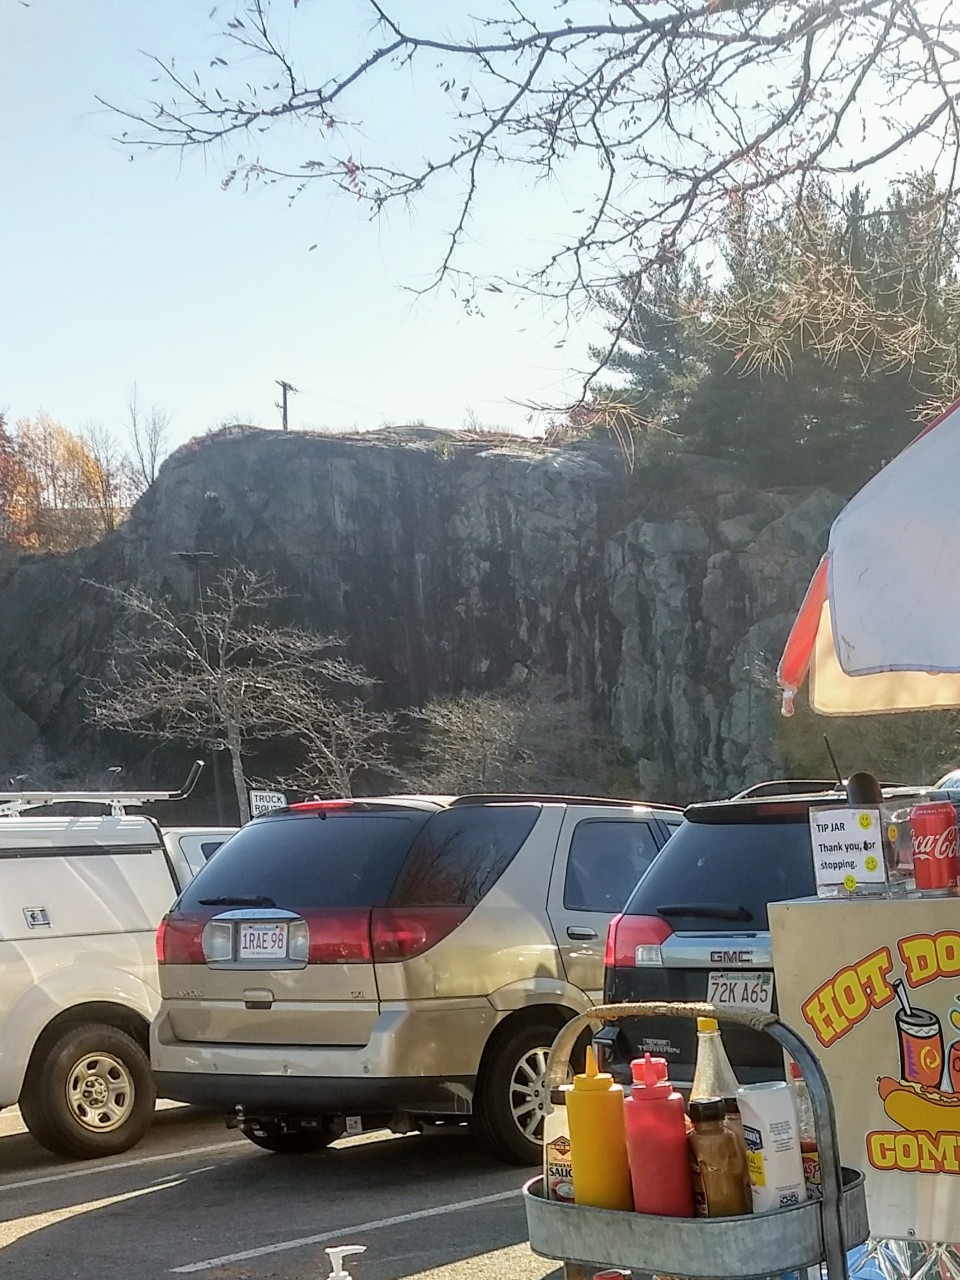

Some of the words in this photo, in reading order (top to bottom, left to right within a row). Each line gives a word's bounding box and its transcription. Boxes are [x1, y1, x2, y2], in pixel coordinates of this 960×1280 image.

[254, 794, 283, 804] TRUCK
[816, 824, 829, 833] TIP
[830, 822, 846, 832] JAR
[818, 842, 844, 853] Thank
[820, 860, 858, 871] stopping.
[242, 932, 268, 951] 1RAE
[270, 932, 285, 950] 98
[710, 951, 753, 963] GMC
[709, 982, 738, 1003] 72K
[741, 984, 768, 1004] A65
[805, 951, 892, 1043] HOT
